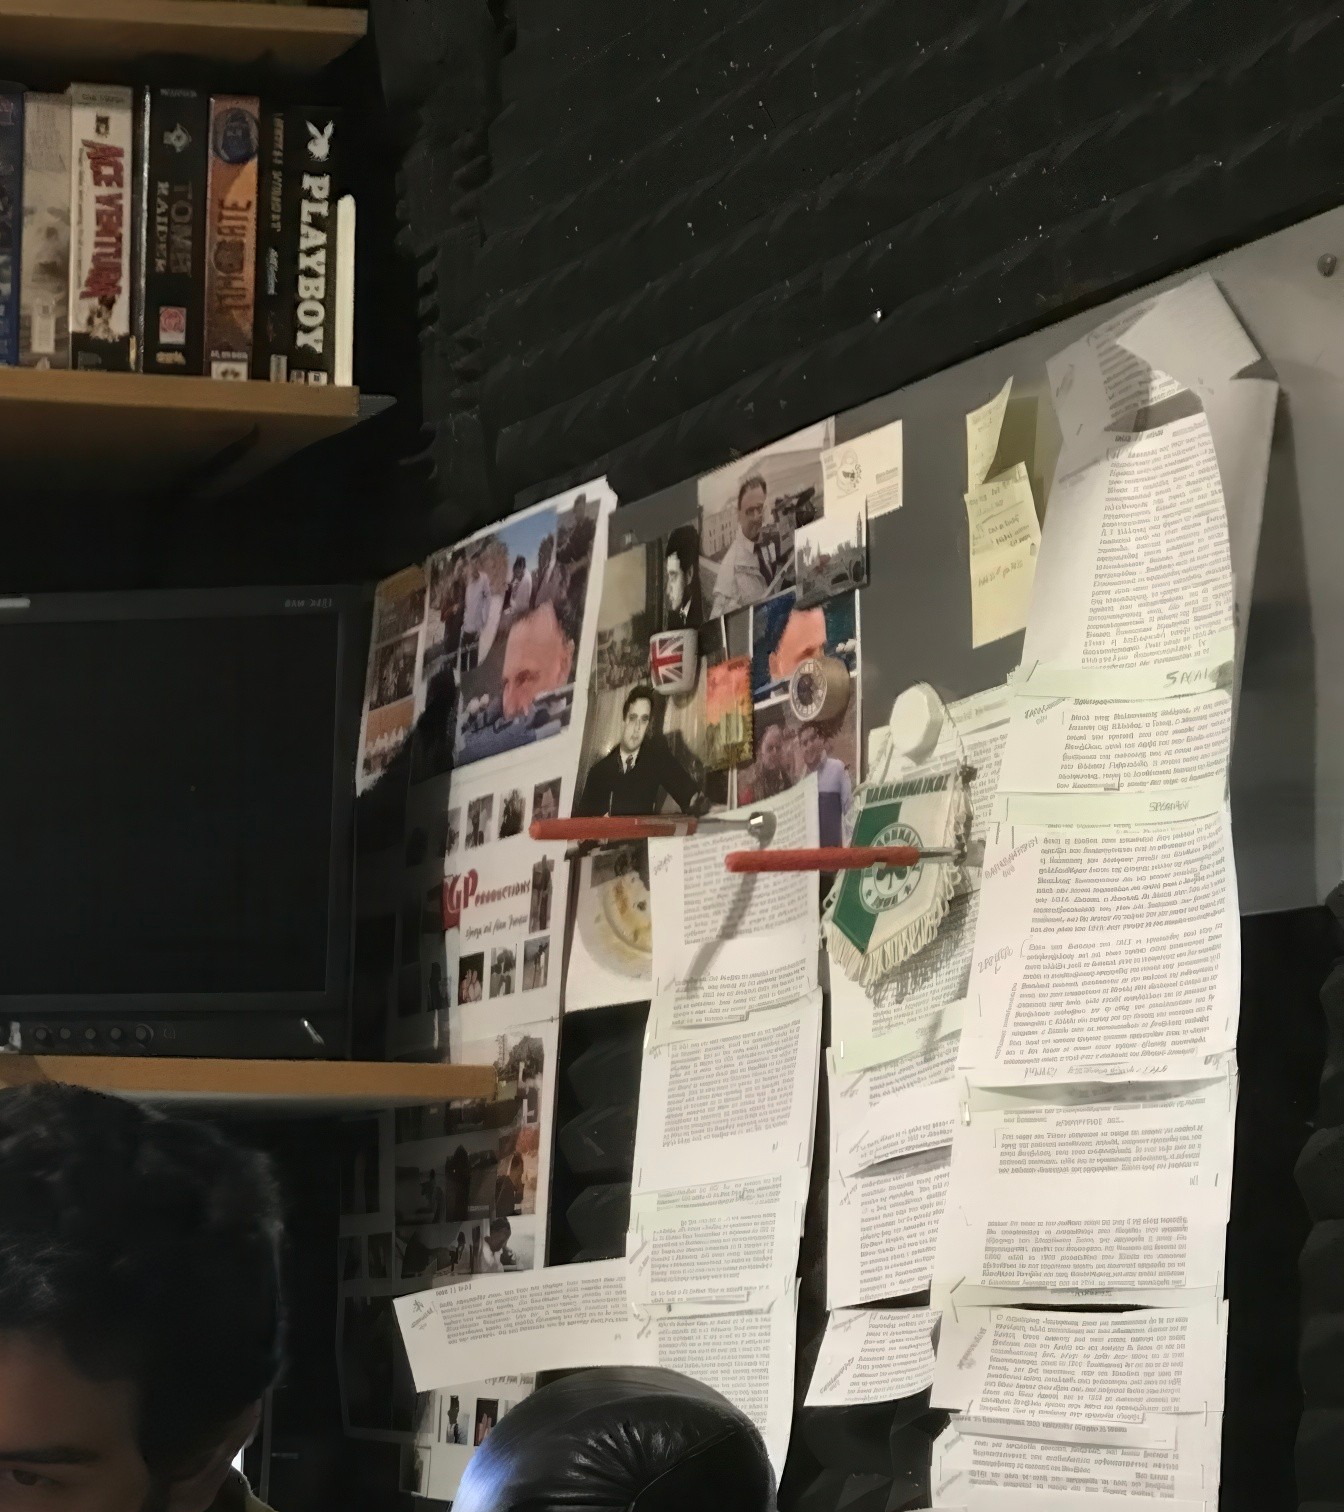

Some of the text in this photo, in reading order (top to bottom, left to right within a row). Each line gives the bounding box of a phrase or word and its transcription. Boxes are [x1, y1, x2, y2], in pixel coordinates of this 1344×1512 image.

[82, 139, 124, 188] ACE
[79, 193, 124, 300] VENTURA
[155, 180, 169, 275] RAIDER
[169, 181, 193, 277] TOMB
[295, 171, 332, 354] PLAYBOY
